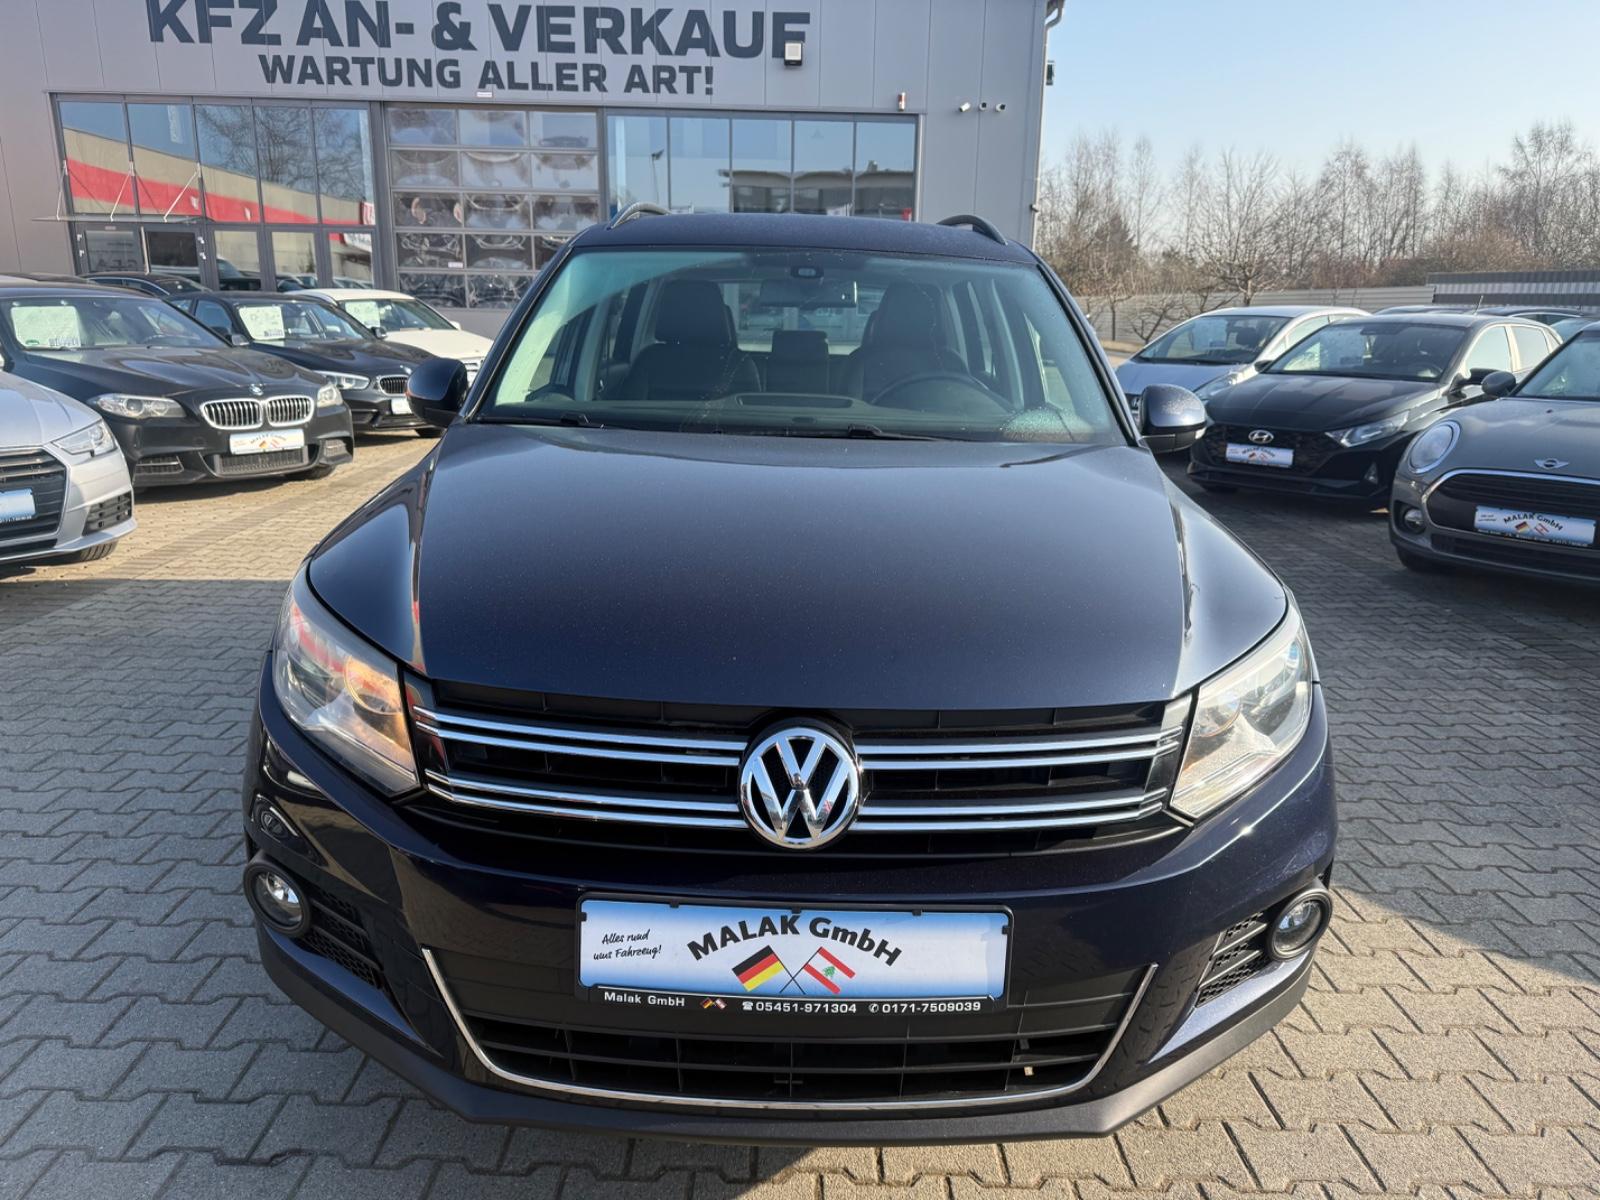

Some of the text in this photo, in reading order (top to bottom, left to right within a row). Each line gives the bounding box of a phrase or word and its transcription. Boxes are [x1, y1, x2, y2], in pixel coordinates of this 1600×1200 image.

[147, 0, 810, 58] KFZ AN- & VERKAUF
[258, 54, 713, 95] WARTUNG ALLER ART!
[1503, 513, 1535, 524] MALAK
[1537, 514, 1563, 531] GmbH
[741, 727, 859, 849] VW
[602, 928, 651, 945] Alles rund
[615, 944, 662, 960] Fahrzeug!
[686, 915, 902, 967] MALAK GmbH
[603, 991, 981, 1014] Malak GmbH 05451-971304 0171-7509039
